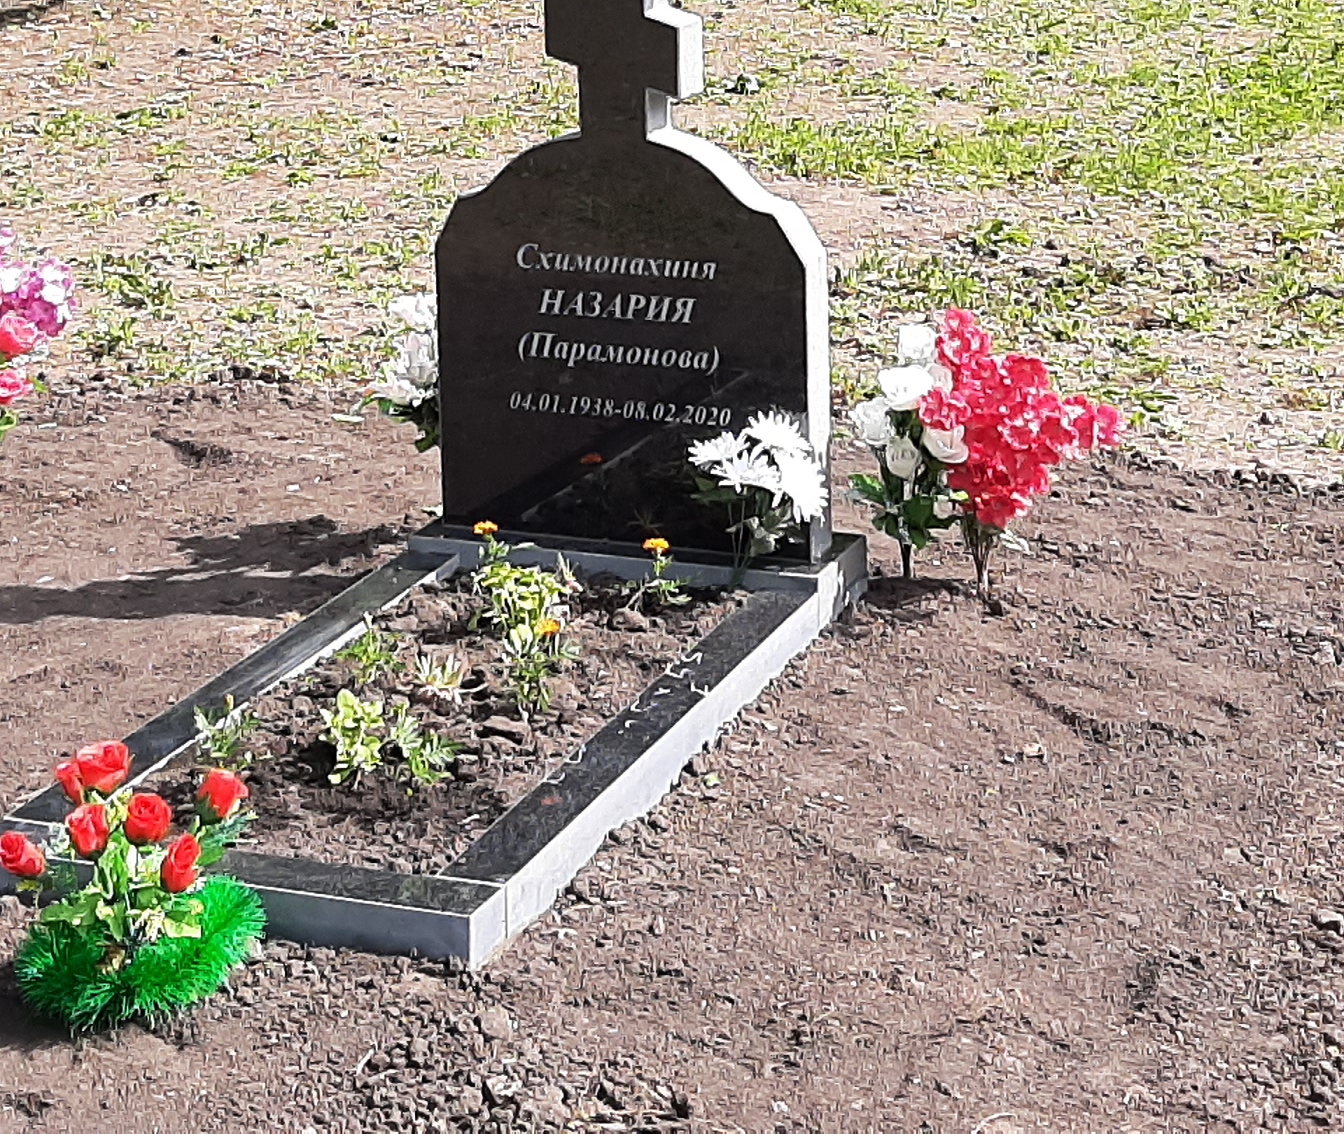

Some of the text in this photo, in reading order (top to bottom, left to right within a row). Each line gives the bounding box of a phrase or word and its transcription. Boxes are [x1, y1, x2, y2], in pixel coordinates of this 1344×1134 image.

[515, 242, 718, 280] Схимонахиня
[538, 289, 697, 324] НАЗАРИЯ
[517, 331, 721, 376] (Парамонова)
[509, 392, 732, 427] 04.01.1938-08.02.2020
